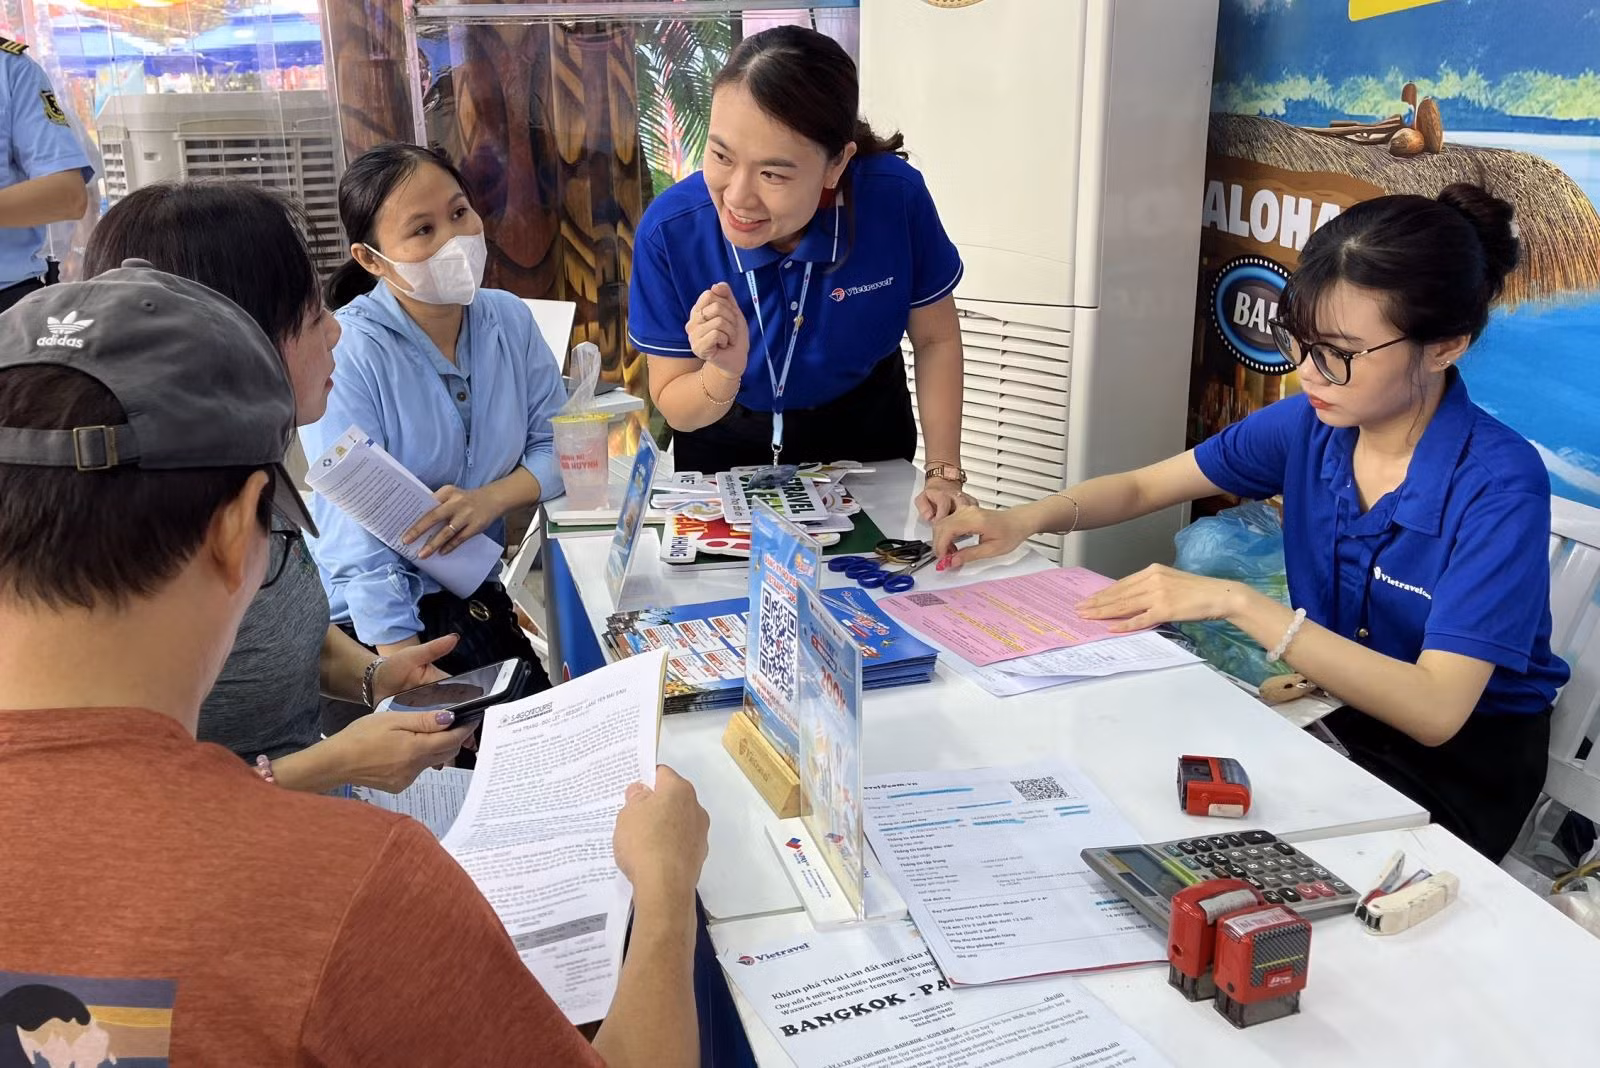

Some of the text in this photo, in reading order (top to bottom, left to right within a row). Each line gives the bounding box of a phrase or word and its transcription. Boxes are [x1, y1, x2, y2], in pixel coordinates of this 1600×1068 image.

[845, 277, 893, 297] Vietravel
[36, 334, 84, 349] adidas
[1381, 573, 1424, 595] Vietravel
[1312, 866, 1328, 876] 00
[755, 942, 810, 961] Vietravel
[771, 951, 922, 1000] Khám phá Thái Lan đất nước của
[868, 971, 897, 982] Jomtien
[781, 1000, 822, 1016] Waxworks
[828, 993, 844, 1001] Wat
[845, 987, 864, 997] Arun
[887, 976, 906, 984] Siam
[779, 993, 906, 1037] BANGKOK
